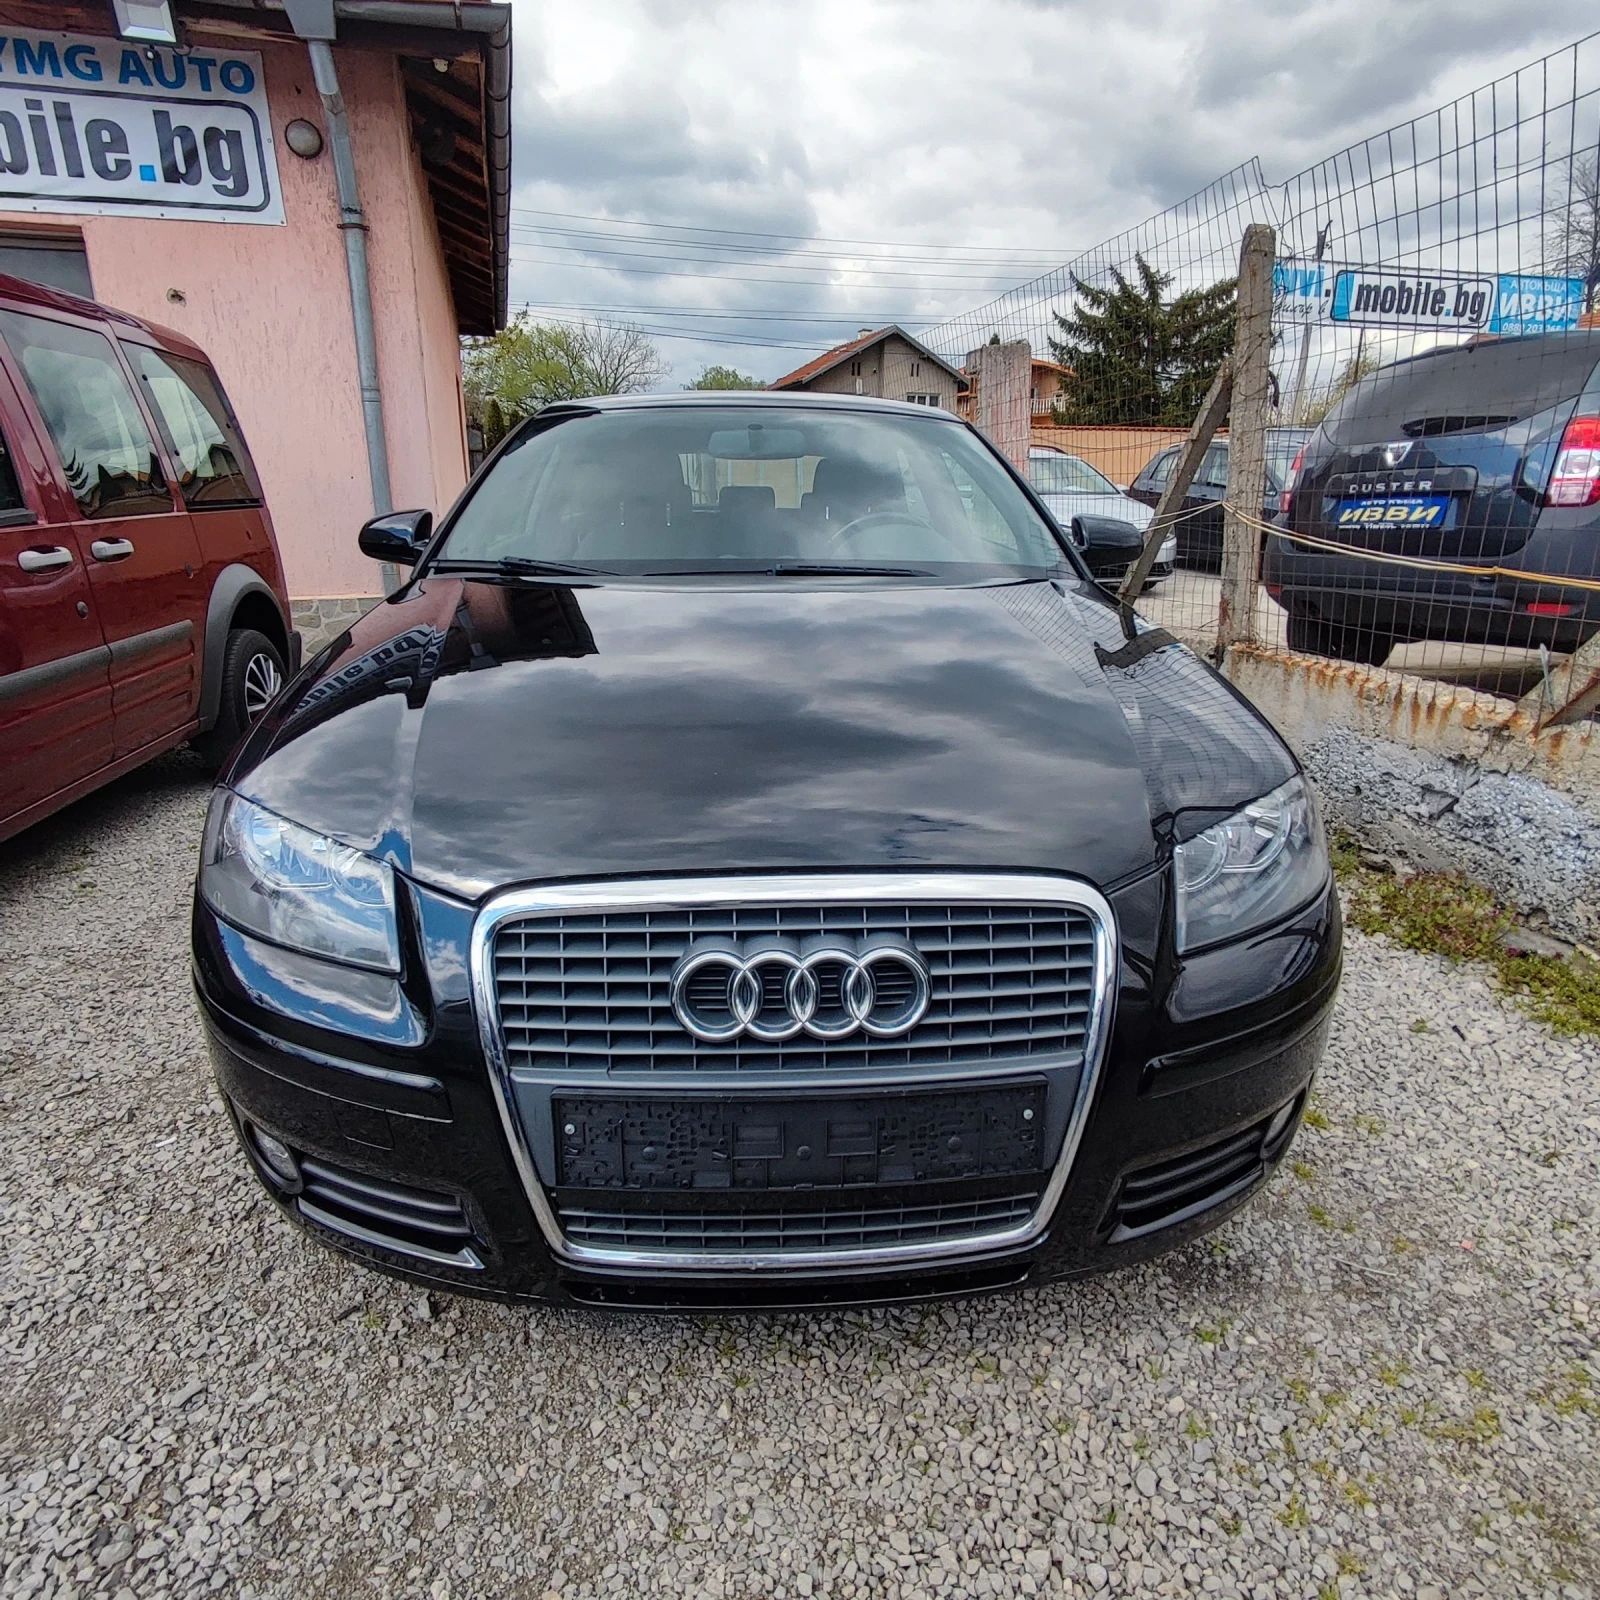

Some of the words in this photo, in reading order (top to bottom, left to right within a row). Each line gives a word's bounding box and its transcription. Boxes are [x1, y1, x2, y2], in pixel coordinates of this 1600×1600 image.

[0, 37, 103, 82] MG
[118, 48, 256, 95] AUTO
[1354, 280, 1485, 323] mobile.bg
[1500, 292, 1573, 322] ИВВИ
[1349, 480, 1433, 494] DUSTER
[1338, 506, 1441, 523] ИВВИ
